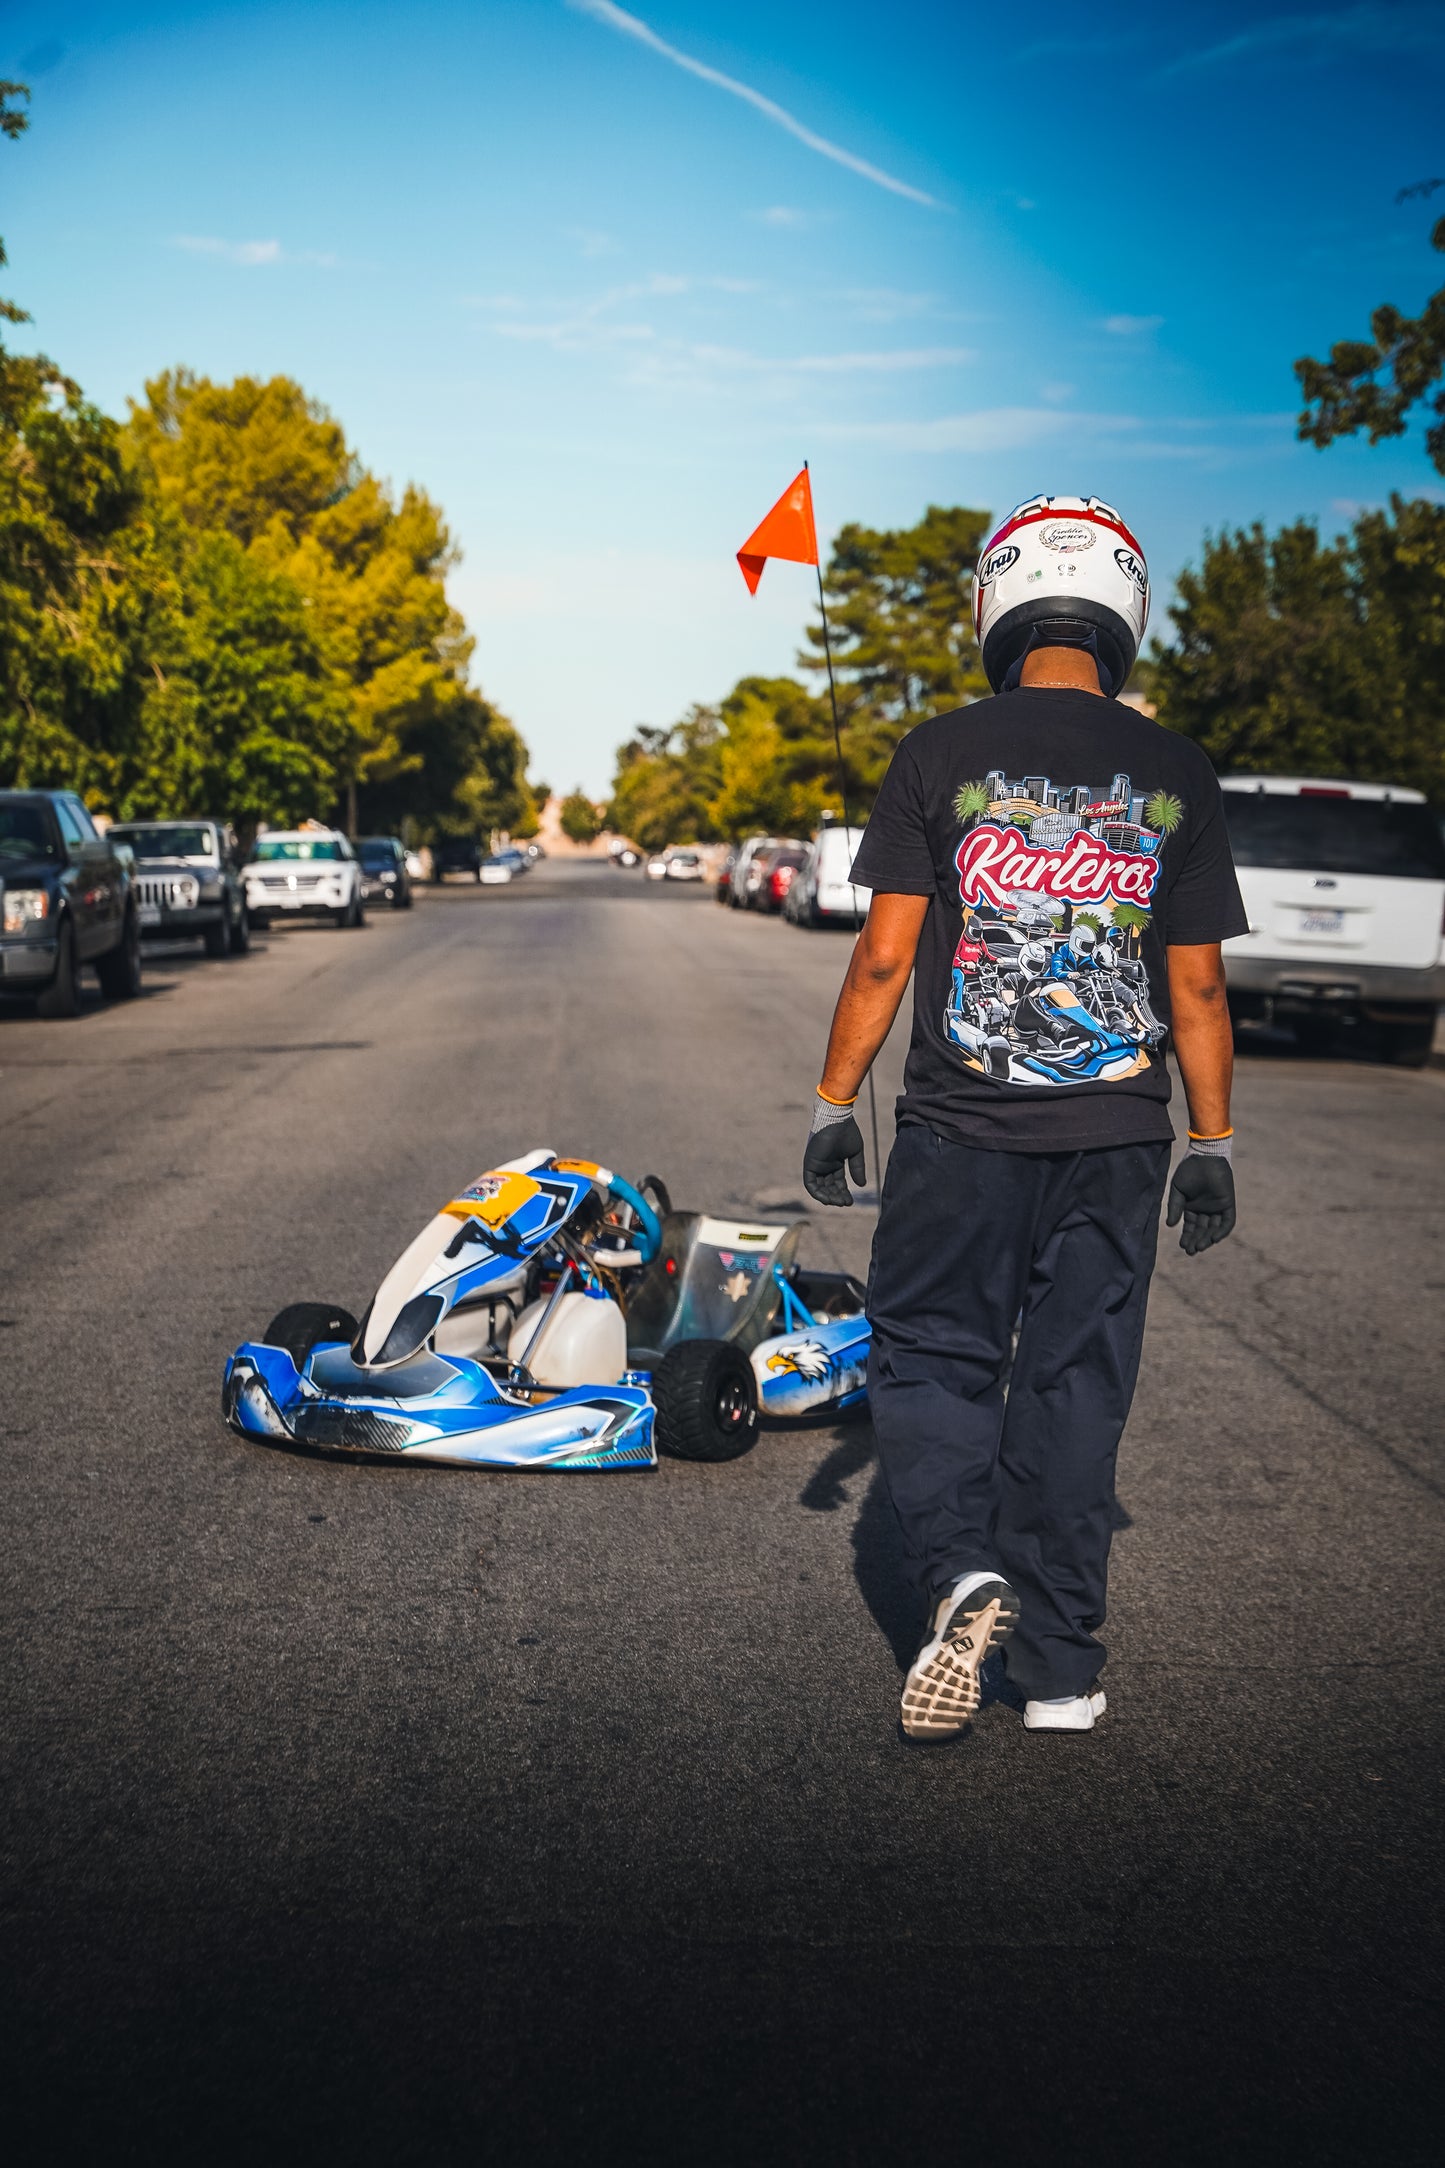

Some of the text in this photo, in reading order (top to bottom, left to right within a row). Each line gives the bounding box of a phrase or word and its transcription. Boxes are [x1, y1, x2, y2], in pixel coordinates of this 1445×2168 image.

[981, 547, 1013, 583] Arai
[1117, 556, 1146, 589] Arai
[1079, 801, 1129, 816] Los Angeles
[1142, 837, 1154, 850] 101
[963, 834, 1150, 900] Karteros
